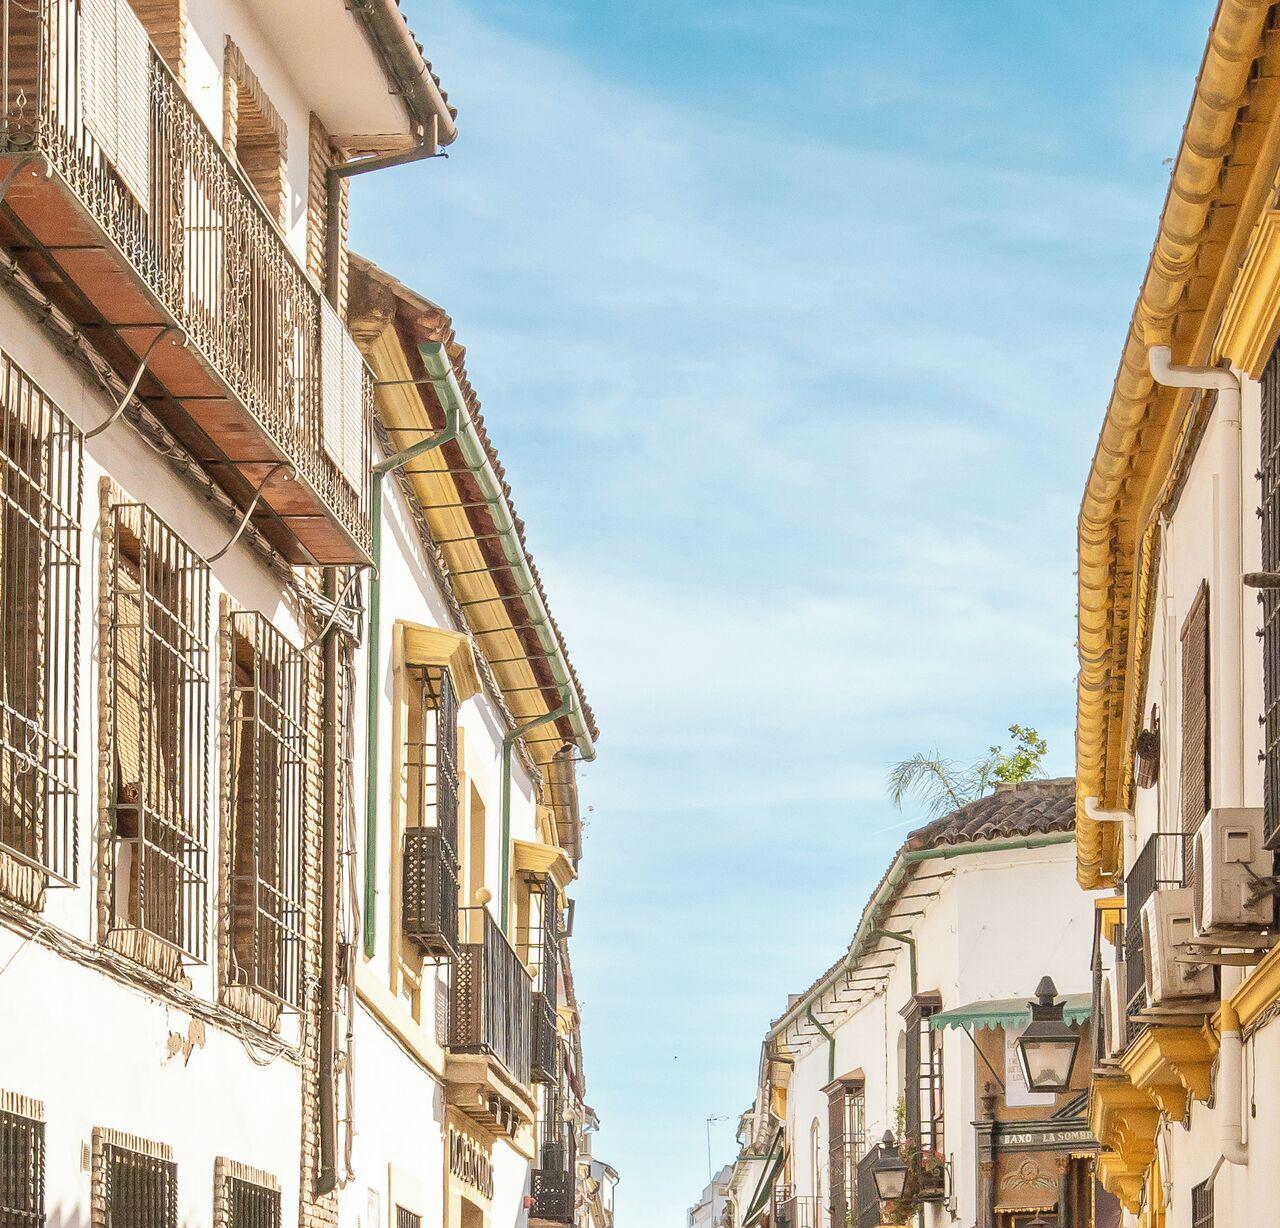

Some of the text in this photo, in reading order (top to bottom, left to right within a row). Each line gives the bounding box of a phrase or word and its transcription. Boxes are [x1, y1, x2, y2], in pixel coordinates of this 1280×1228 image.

[1004, 1131, 1097, 1144] BAXO LA SOMBR
